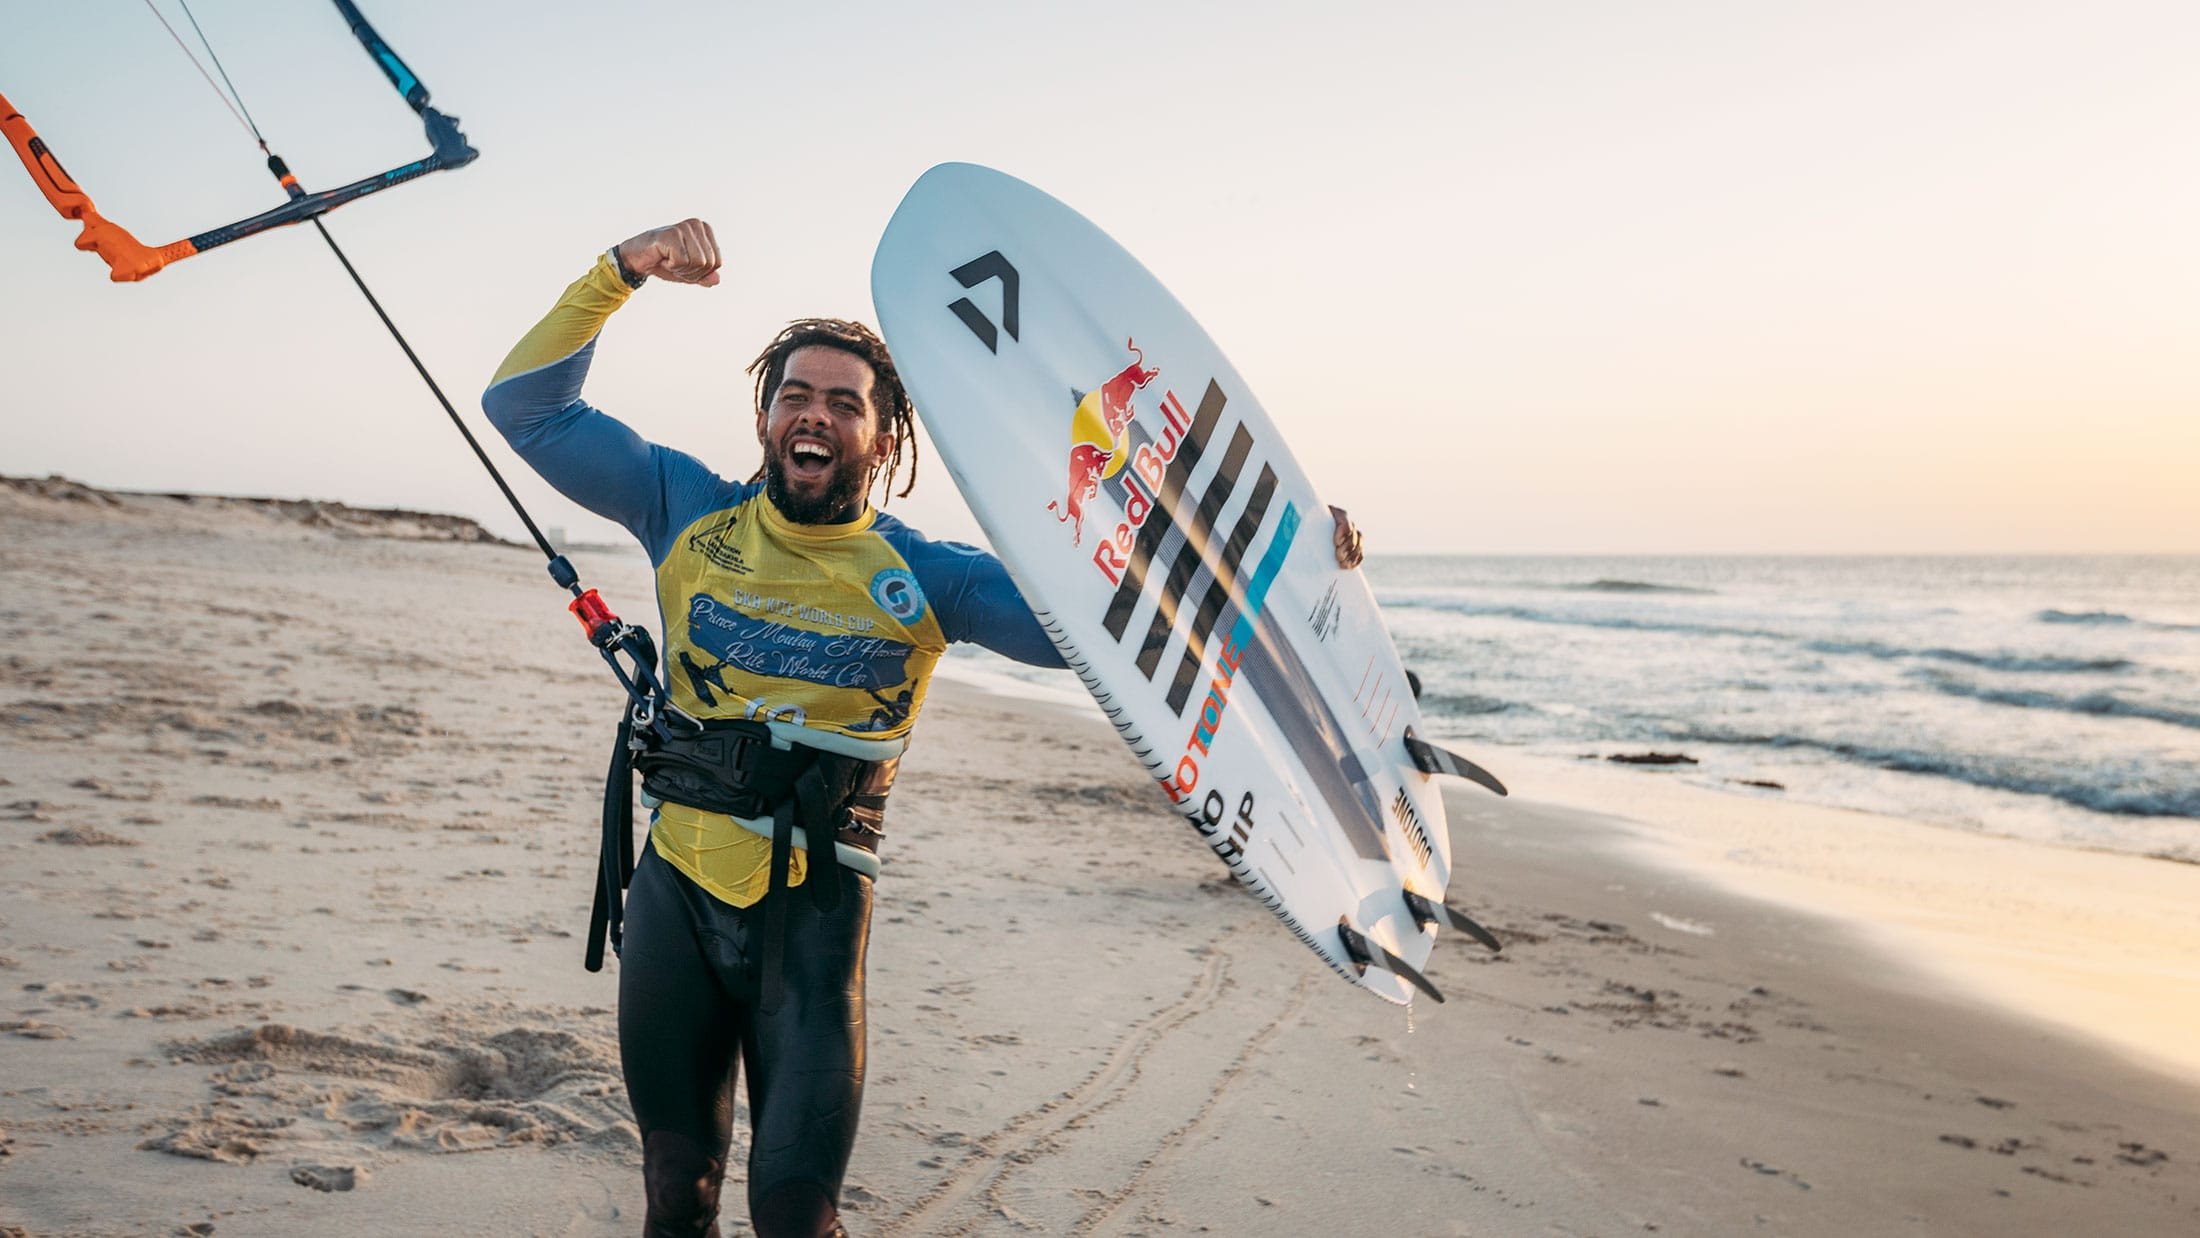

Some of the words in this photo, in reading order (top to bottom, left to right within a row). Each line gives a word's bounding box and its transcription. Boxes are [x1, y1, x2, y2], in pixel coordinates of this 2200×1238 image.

[1092, 475, 1151, 588] Red
[1134, 389, 1191, 496] Bull
[693, 597, 738, 631] Prince
[740, 620, 817, 653] Moulay
[824, 633, 860, 658] El
[733, 588, 762, 611] GKA
[766, 596, 795, 618] KITE
[797, 604, 844, 628] WORLD
[847, 615, 875, 633] CUP
[771, 650, 834, 680] World
[835, 662, 868, 687] Cup
[1392, 784, 1434, 872] DUOTONE
